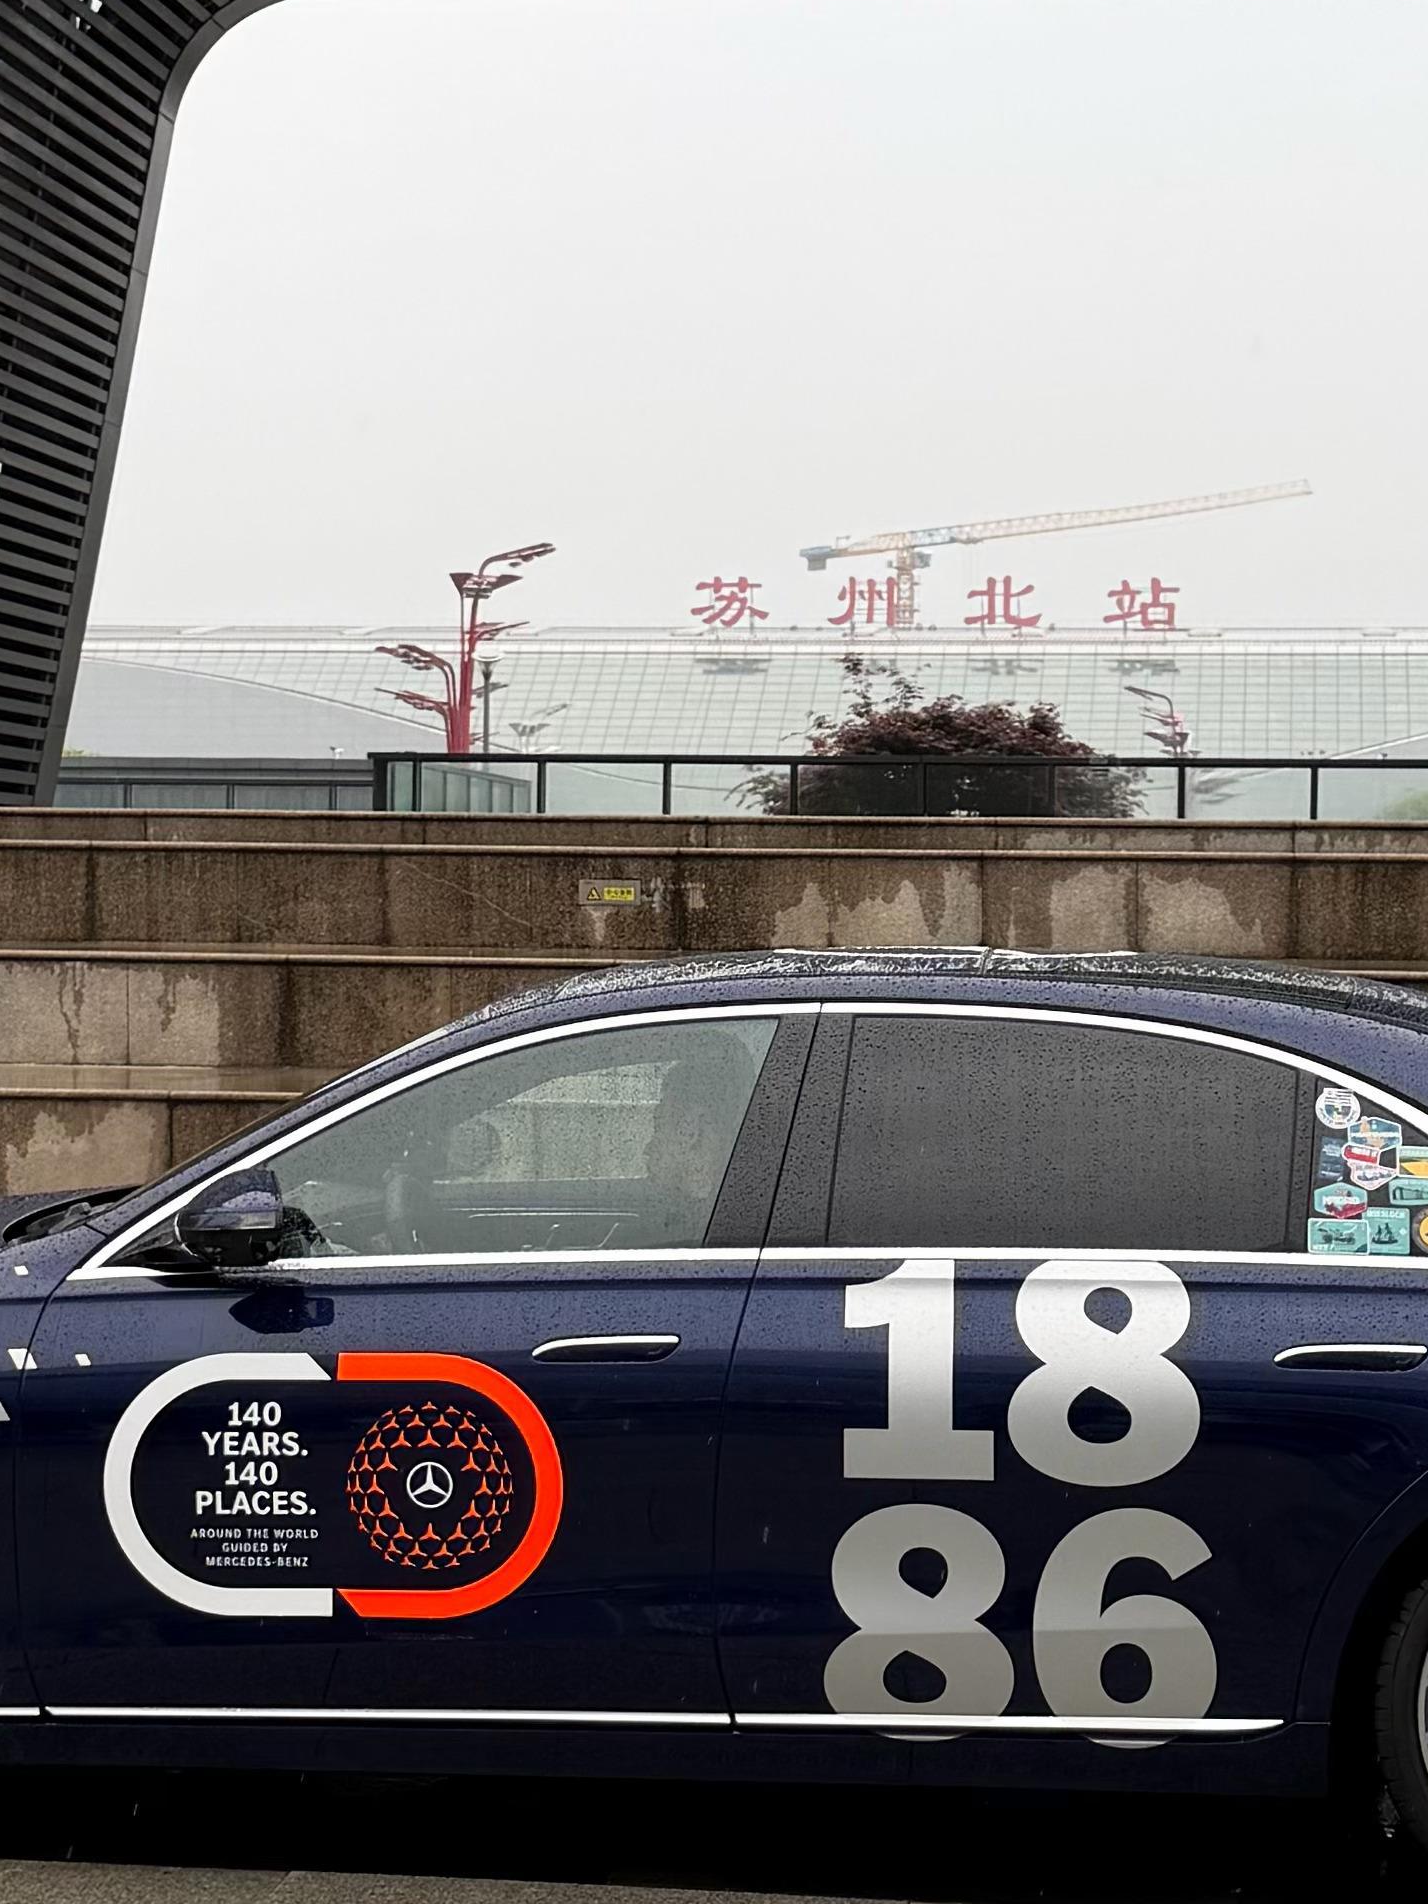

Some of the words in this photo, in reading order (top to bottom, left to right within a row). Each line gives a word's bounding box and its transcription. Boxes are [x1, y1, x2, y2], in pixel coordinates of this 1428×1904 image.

[690, 575, 1180, 630] 苏州北站
[843, 1259, 1201, 1487] 18
[228, 1401, 282, 1426] 140
[201, 1431, 309, 1456] YEARS.
[224, 1461, 278, 1486] 140
[195, 1490, 317, 1515] PLACES.
[190, 1528, 242, 1539] AROUND
[246, 1528, 269, 1539] THE
[273, 1528, 319, 1539] WORLD
[222, 1542, 269, 1553] GUIDED
[273, 1542, 288, 1552] BY
[205, 1556, 309, 1567] MERCEDES-BENZ
[823, 1504, 1217, 1749] 86
